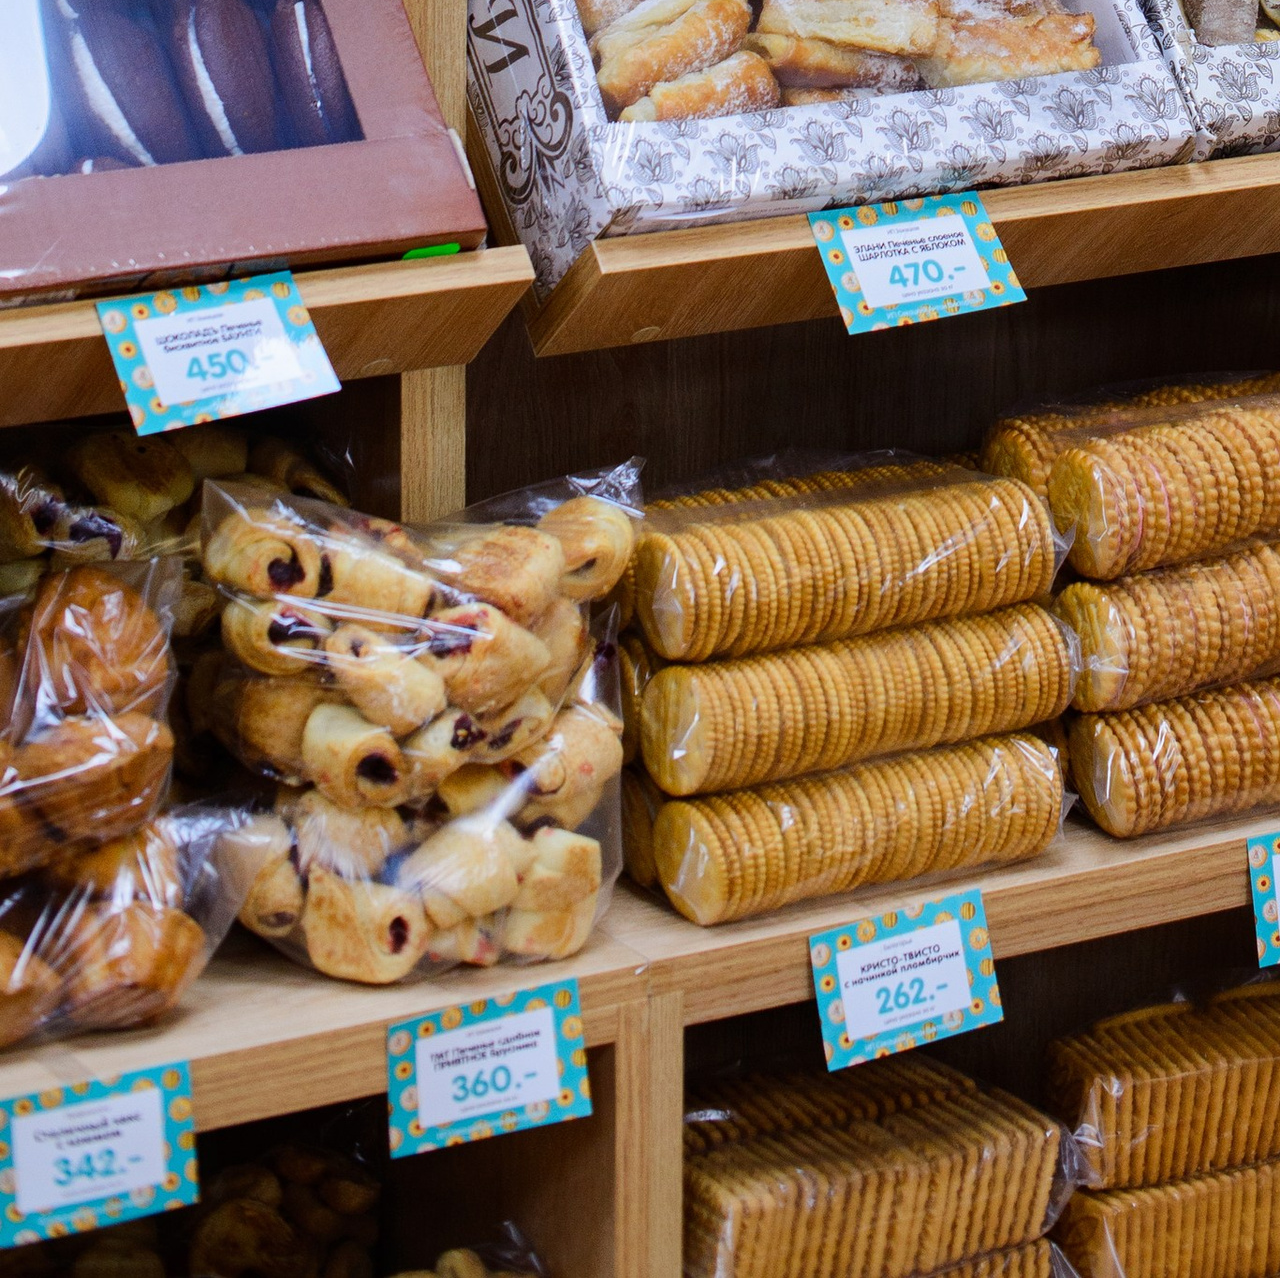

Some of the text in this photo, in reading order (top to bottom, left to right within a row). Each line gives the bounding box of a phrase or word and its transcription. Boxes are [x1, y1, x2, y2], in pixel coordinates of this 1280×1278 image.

[853, 231, 964, 253] ЭЛАНИ Печенье слоеное
[858, 248, 910, 262] ШАРЛОТКА
[920, 238, 966, 252] ЯБЛОКОМ
[852, 965, 898, 987] начинкой
[900, 950, 961, 973] пломбирчик
[860, 944, 941, 974] КРИСТО-ТВИСТО
